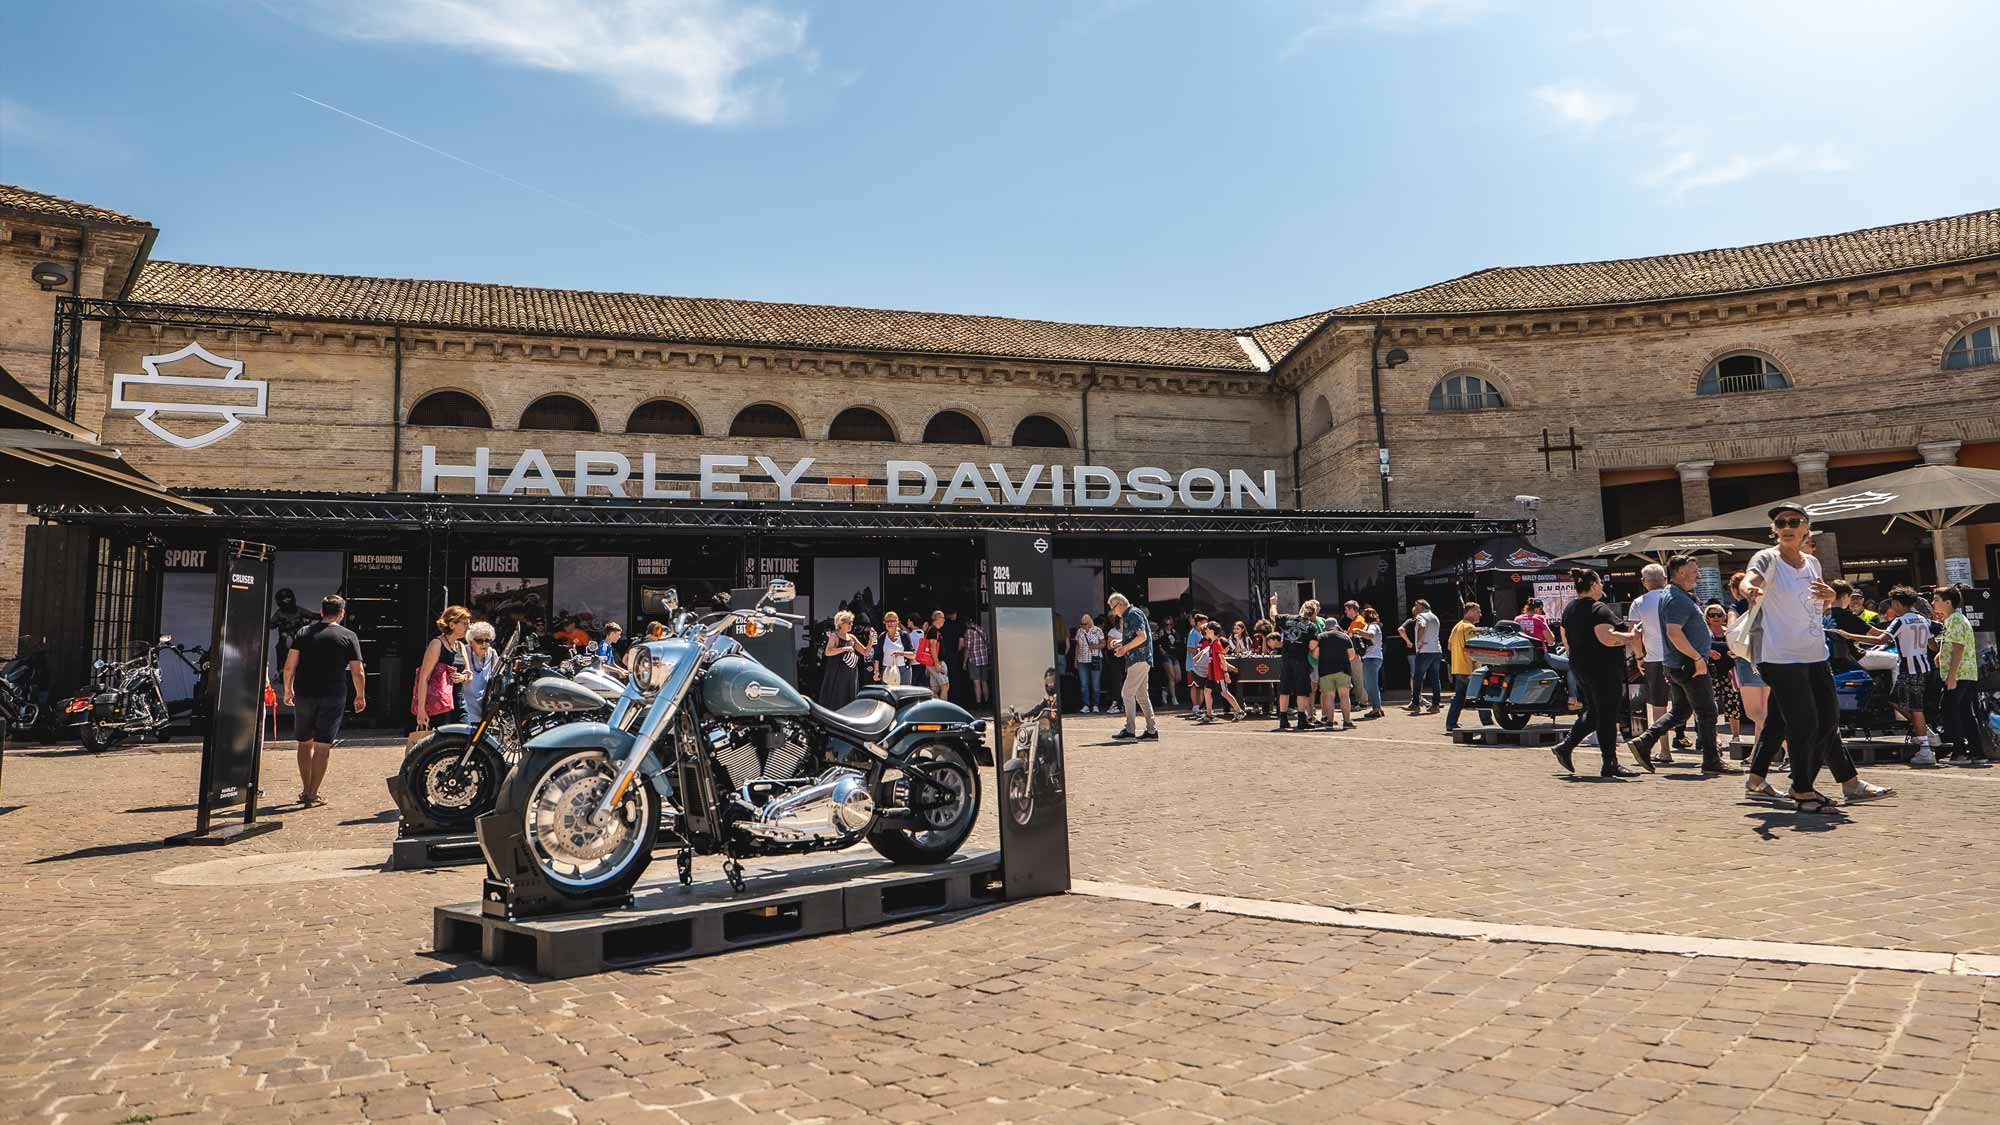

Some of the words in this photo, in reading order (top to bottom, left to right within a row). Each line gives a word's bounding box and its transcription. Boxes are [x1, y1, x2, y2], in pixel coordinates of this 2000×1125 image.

[164, 549, 207, 567] SPORT
[471, 556, 519, 572] CRUISER
[232, 573, 254, 585] CRUISER
[993, 566, 1010, 580] 2024
[994, 581, 1005, 595] FAT
[1022, 582, 1033, 596] 114
[1910, 624, 1928, 649] 10
